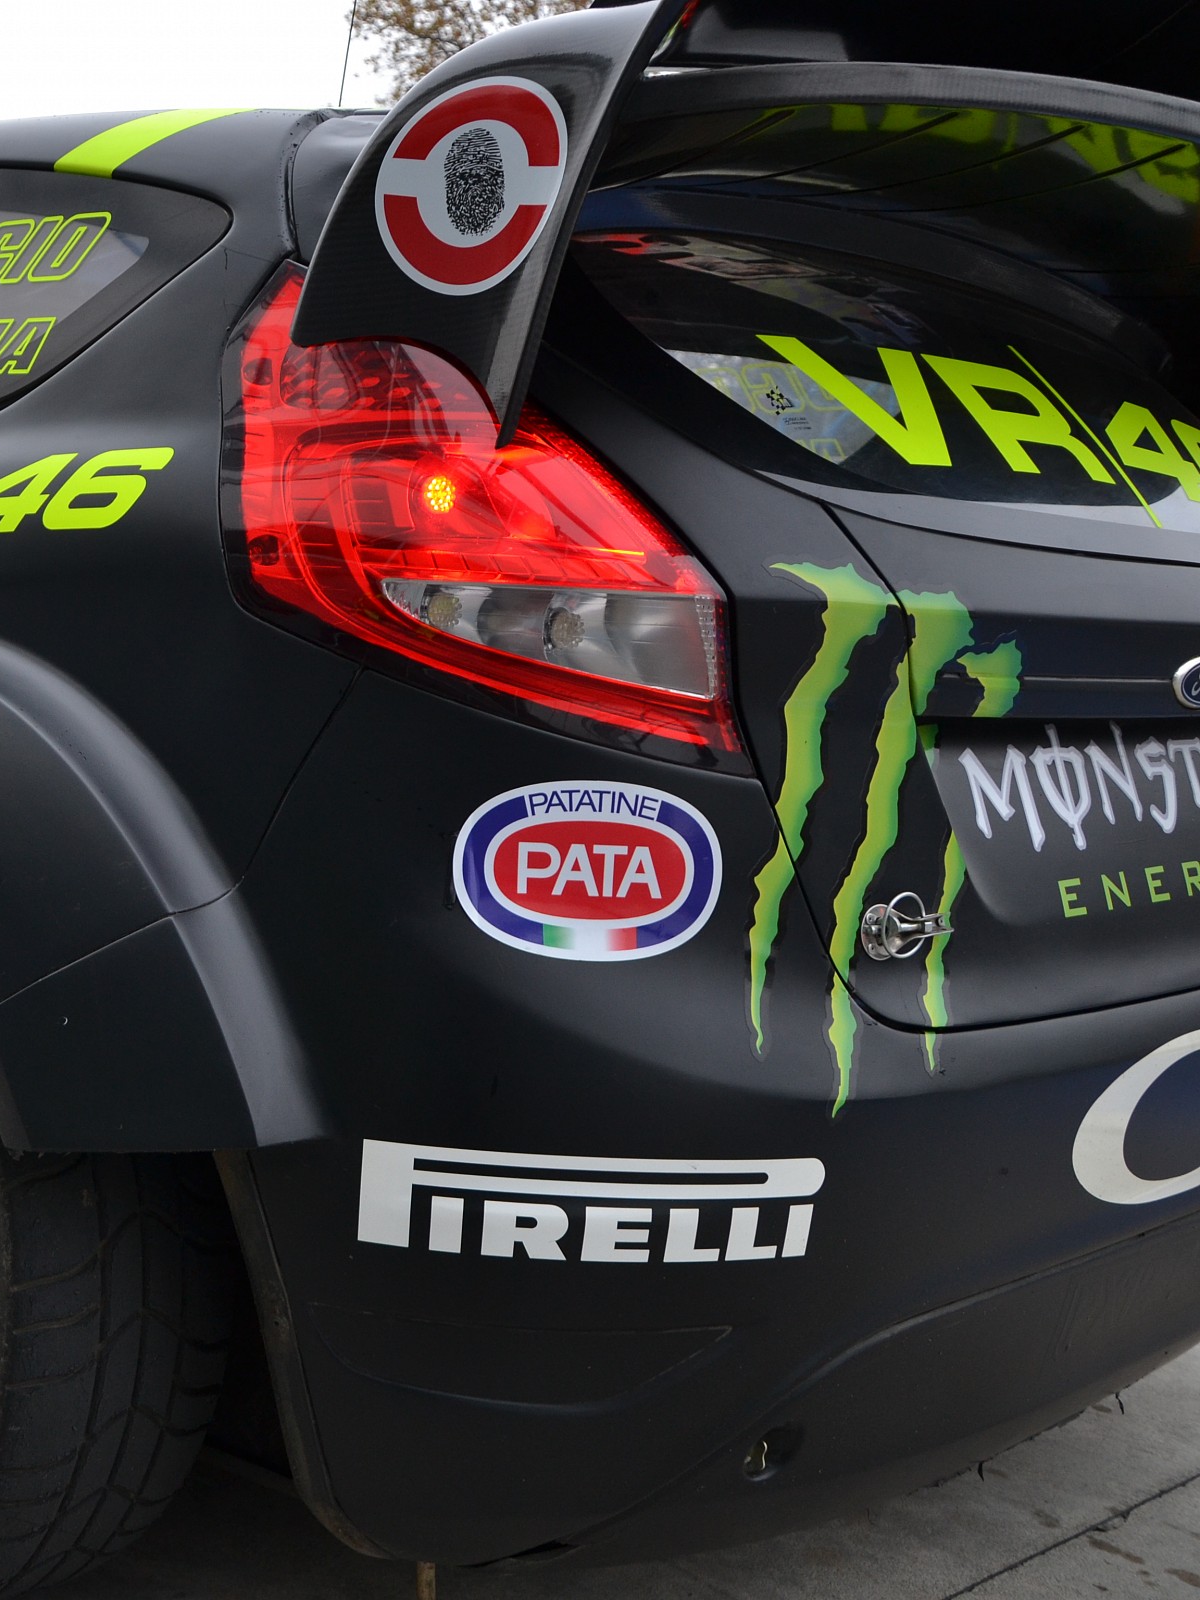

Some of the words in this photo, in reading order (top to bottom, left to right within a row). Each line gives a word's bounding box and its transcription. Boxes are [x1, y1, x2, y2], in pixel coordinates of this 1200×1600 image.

[527, 789, 660, 821] PATATINE
[515, 842, 662, 899] PATA
[357, 1138, 826, 1263] PIRELLI
